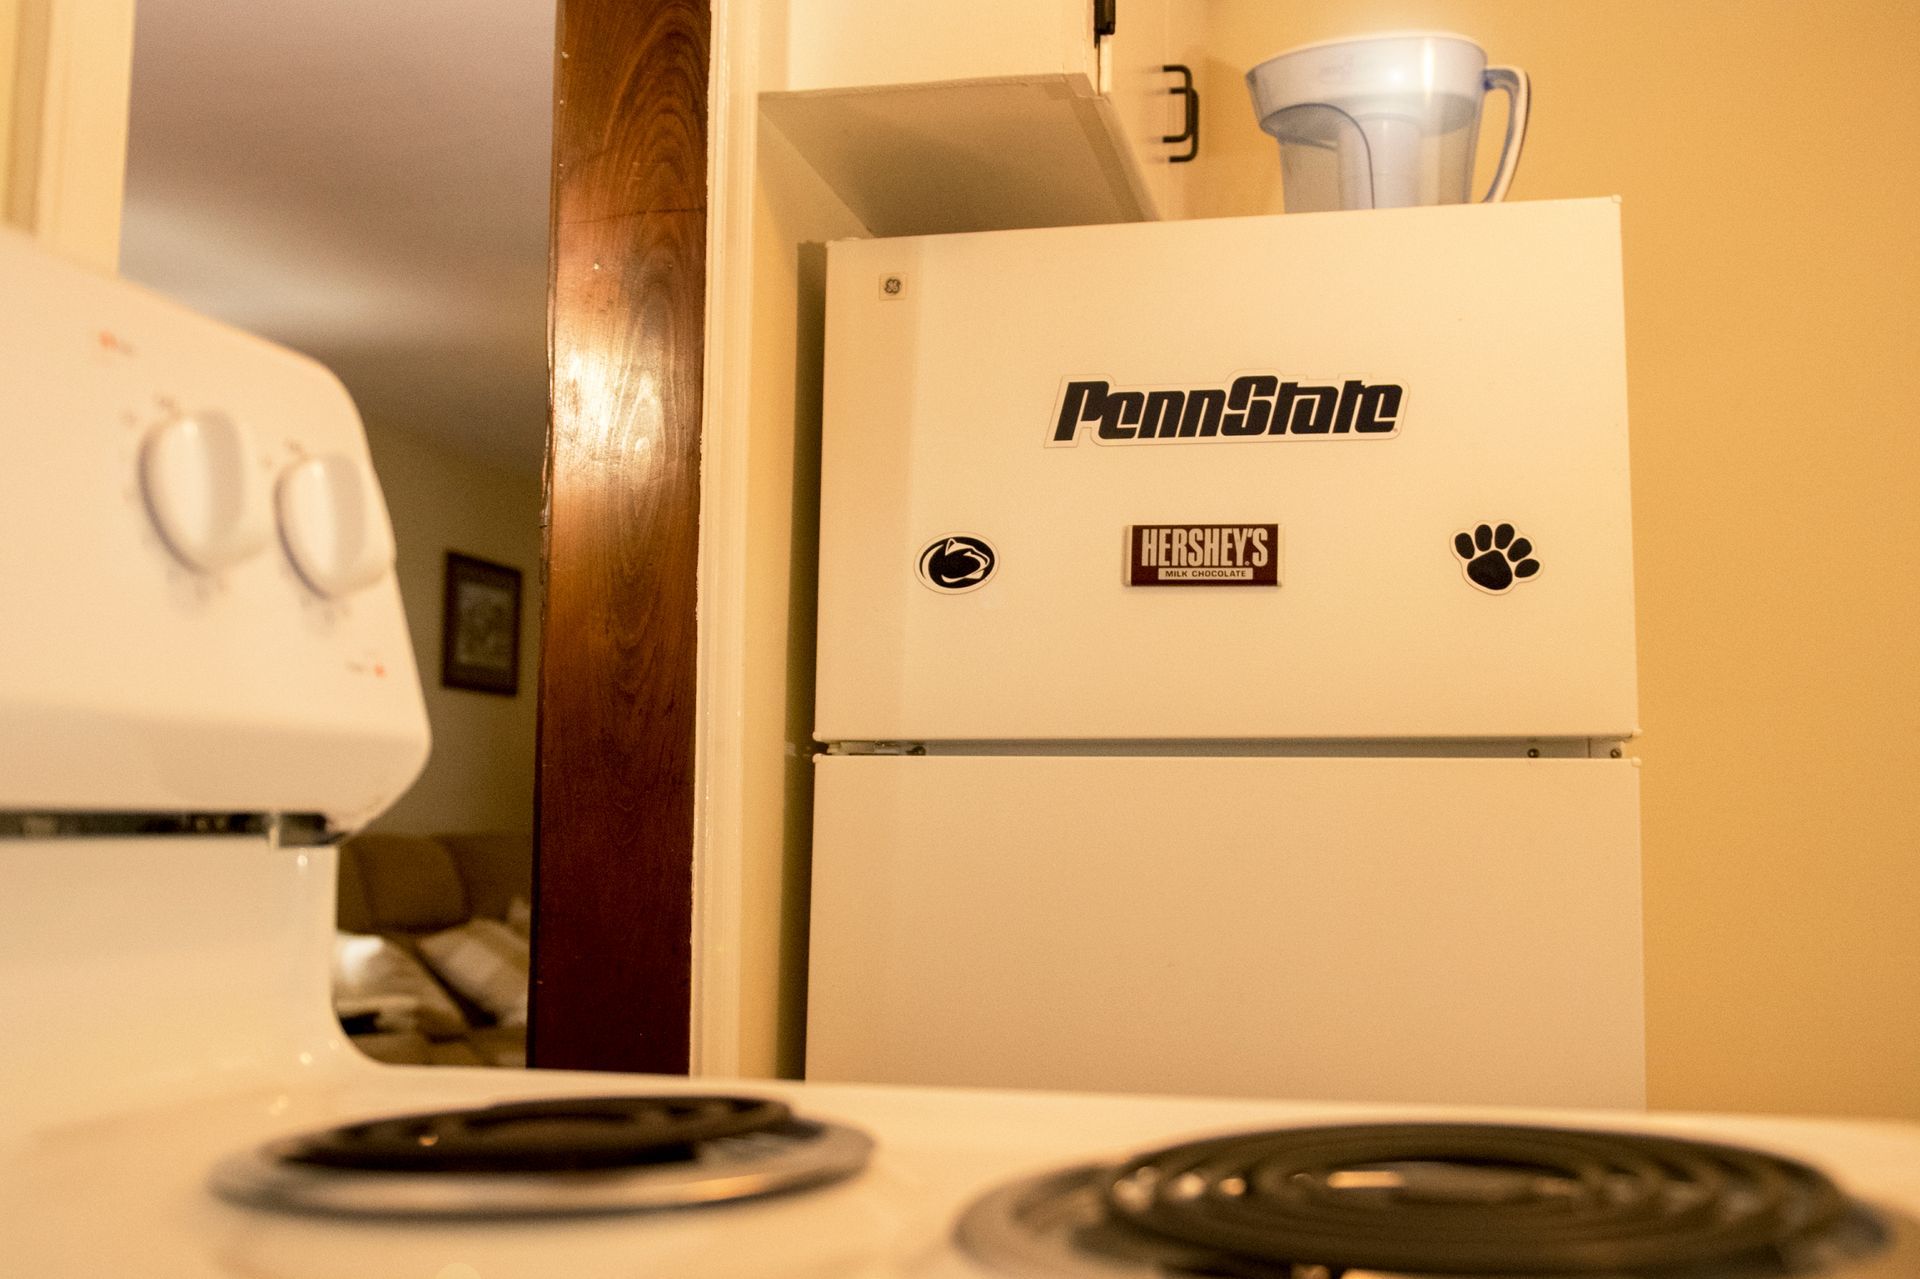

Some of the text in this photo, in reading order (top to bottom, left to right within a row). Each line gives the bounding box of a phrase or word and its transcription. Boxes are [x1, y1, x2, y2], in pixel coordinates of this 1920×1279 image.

[1141, 527, 1269, 567] HERSHEY'S
[1164, 569, 1246, 578] MILK CHOCOLATE
